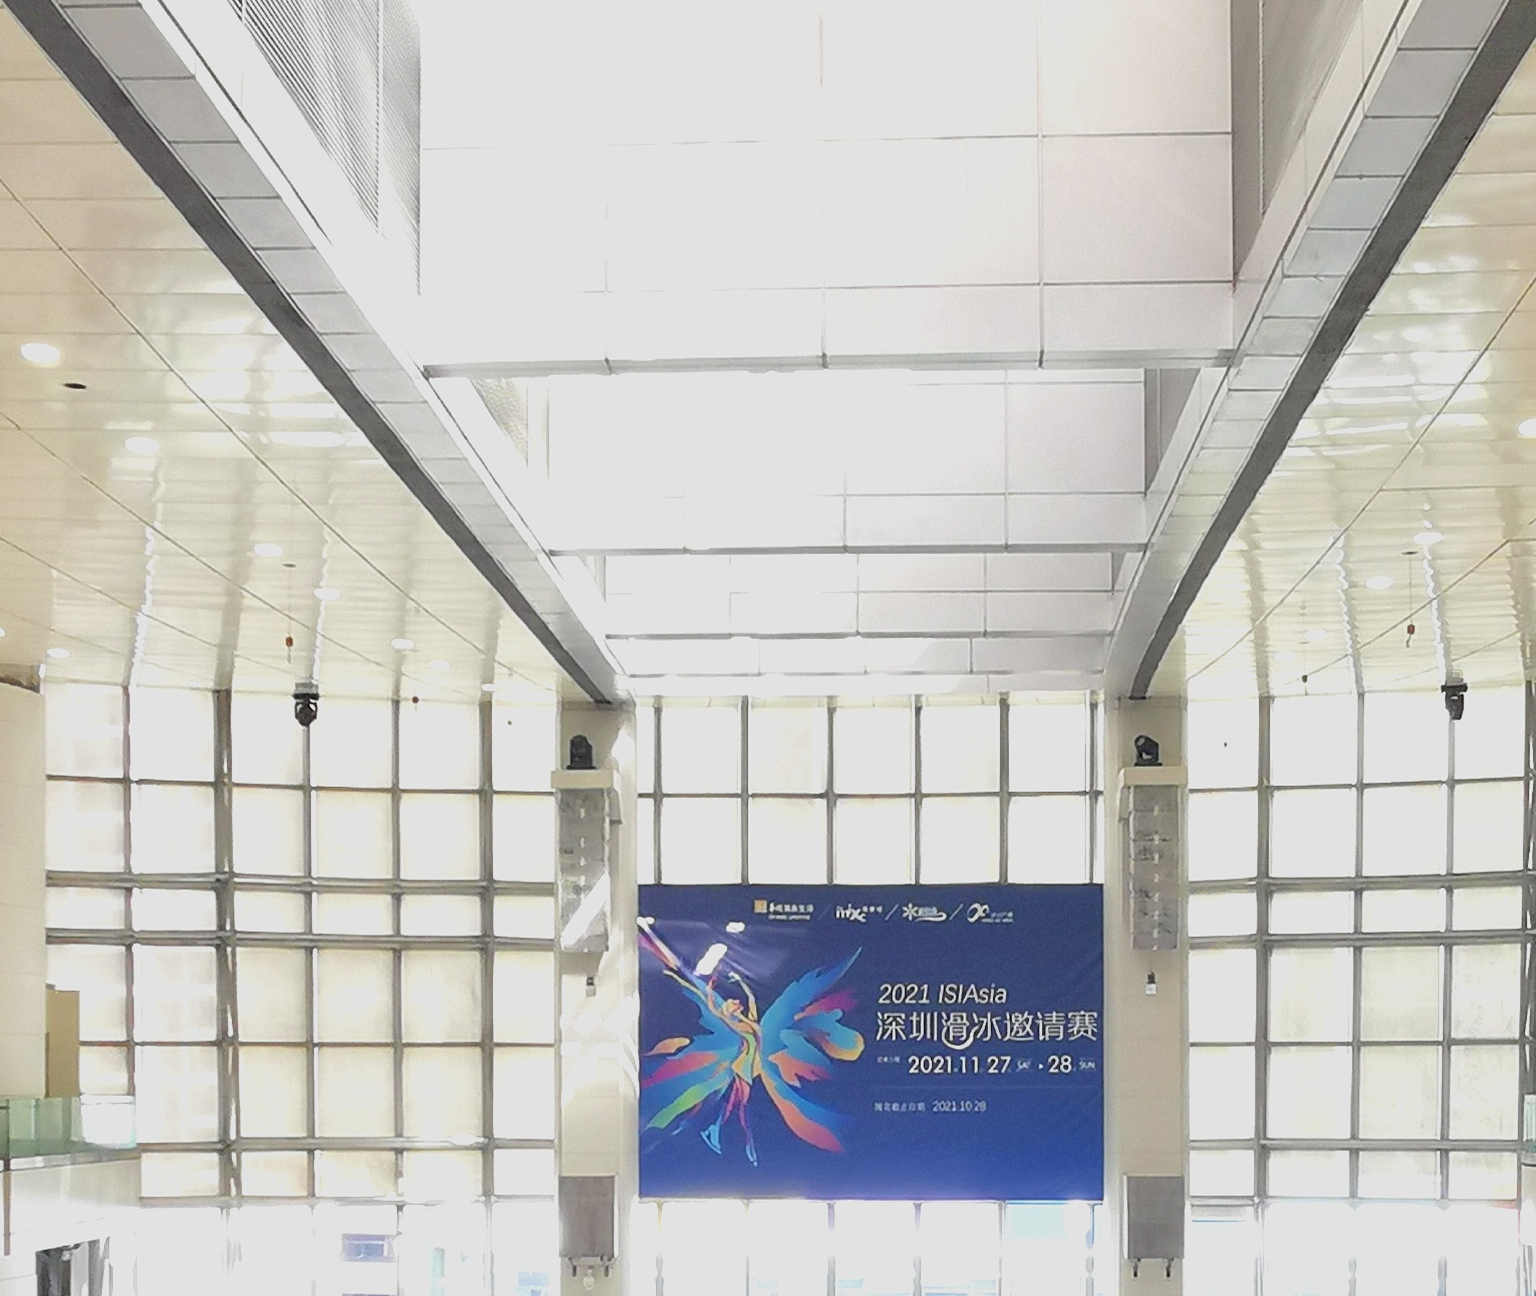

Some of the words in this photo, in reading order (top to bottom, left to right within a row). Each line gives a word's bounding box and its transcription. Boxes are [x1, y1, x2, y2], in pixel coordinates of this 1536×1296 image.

[878, 983, 931, 1004] 2021
[937, 983, 1008, 1004] ISIAsia
[876, 1010, 1099, 1048] 深圳滑冰邀请赛
